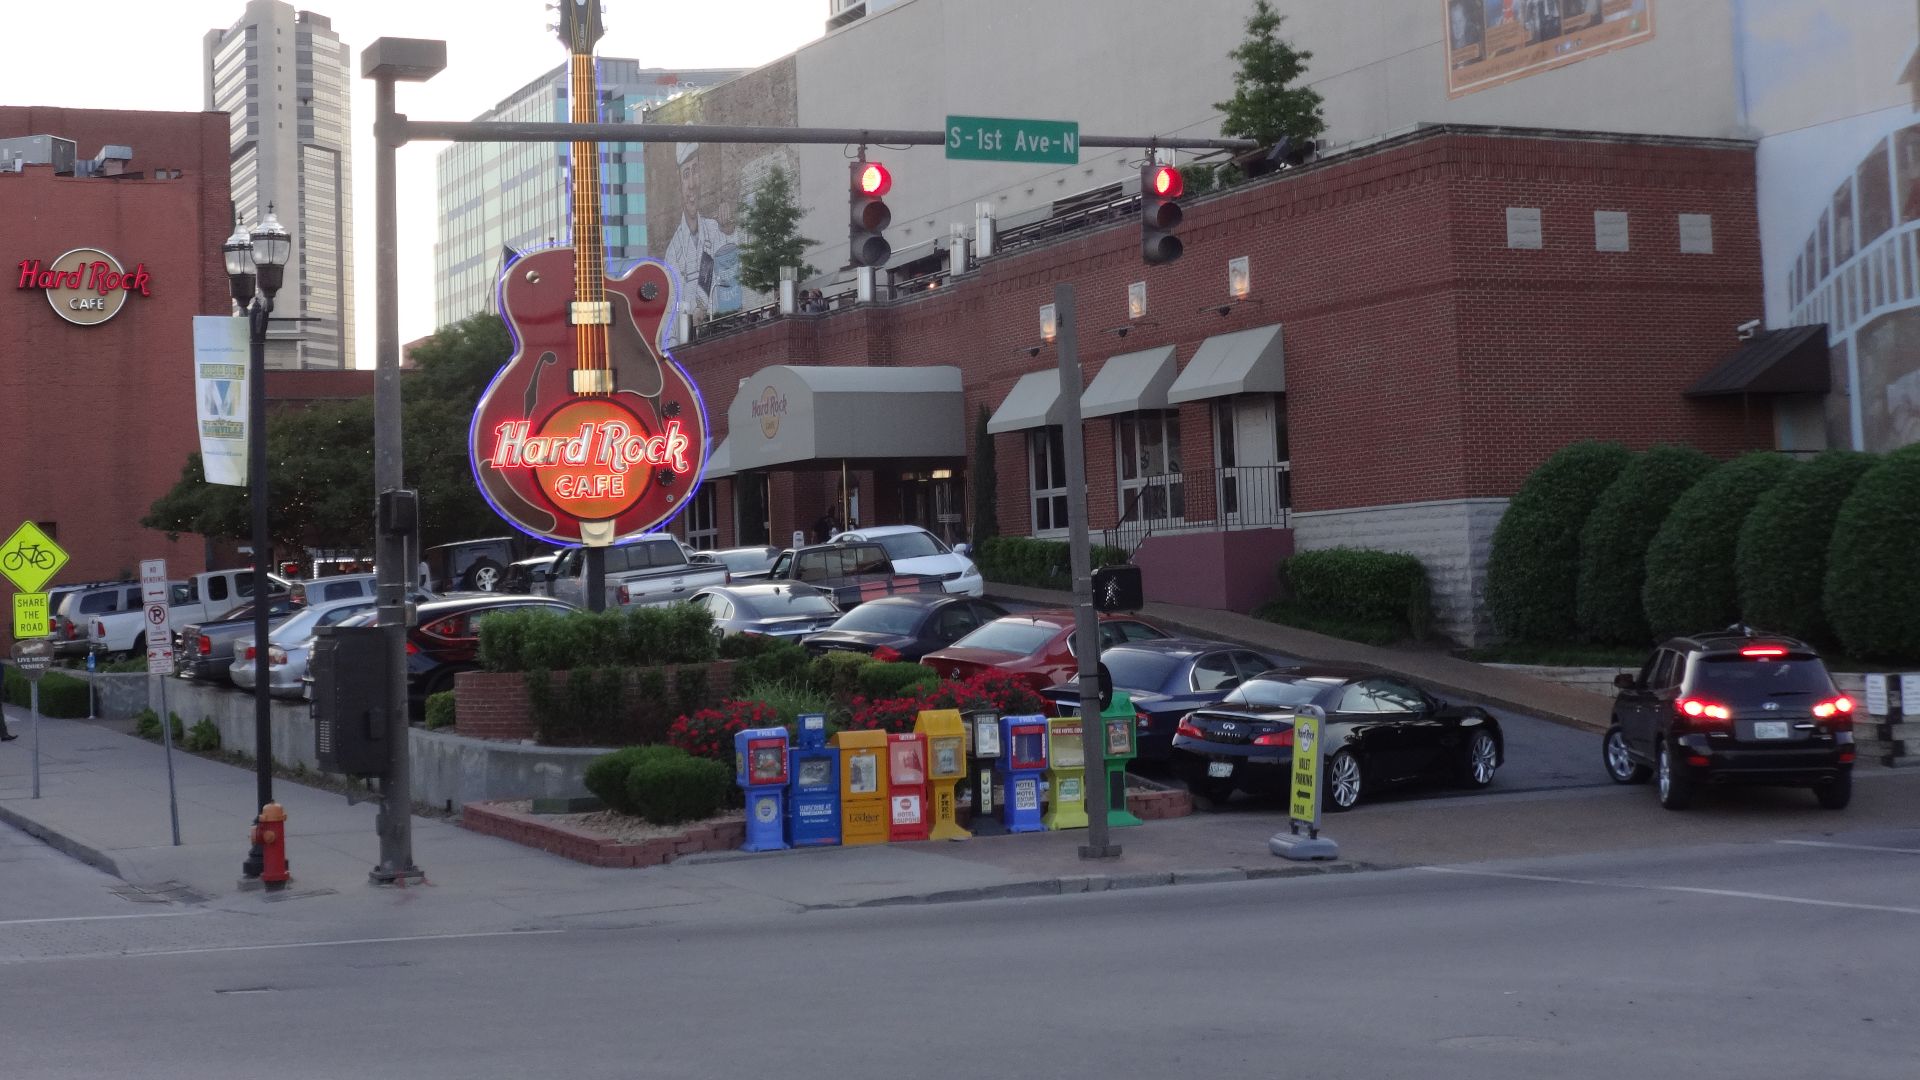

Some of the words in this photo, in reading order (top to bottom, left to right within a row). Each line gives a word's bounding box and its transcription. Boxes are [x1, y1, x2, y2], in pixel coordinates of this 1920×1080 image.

[18, 259, 86, 289] Hard
[88, 260, 151, 297] Rock
[69, 297, 104, 310] CAFE
[751, 397, 769, 418] Hard
[770, 393, 787, 416] Rock
[491, 420, 594, 468] Hard
[597, 420, 689, 473] Rock
[555, 474, 625, 499] CAFE
[17, 598, 45, 607] SHARE
[24, 610, 40, 619] THE
[20, 622, 43, 632] ROAD
[977, 716, 995, 724] FREE
[1295, 772, 1312, 787] PARKING
[849, 811, 879, 823] Ledger
